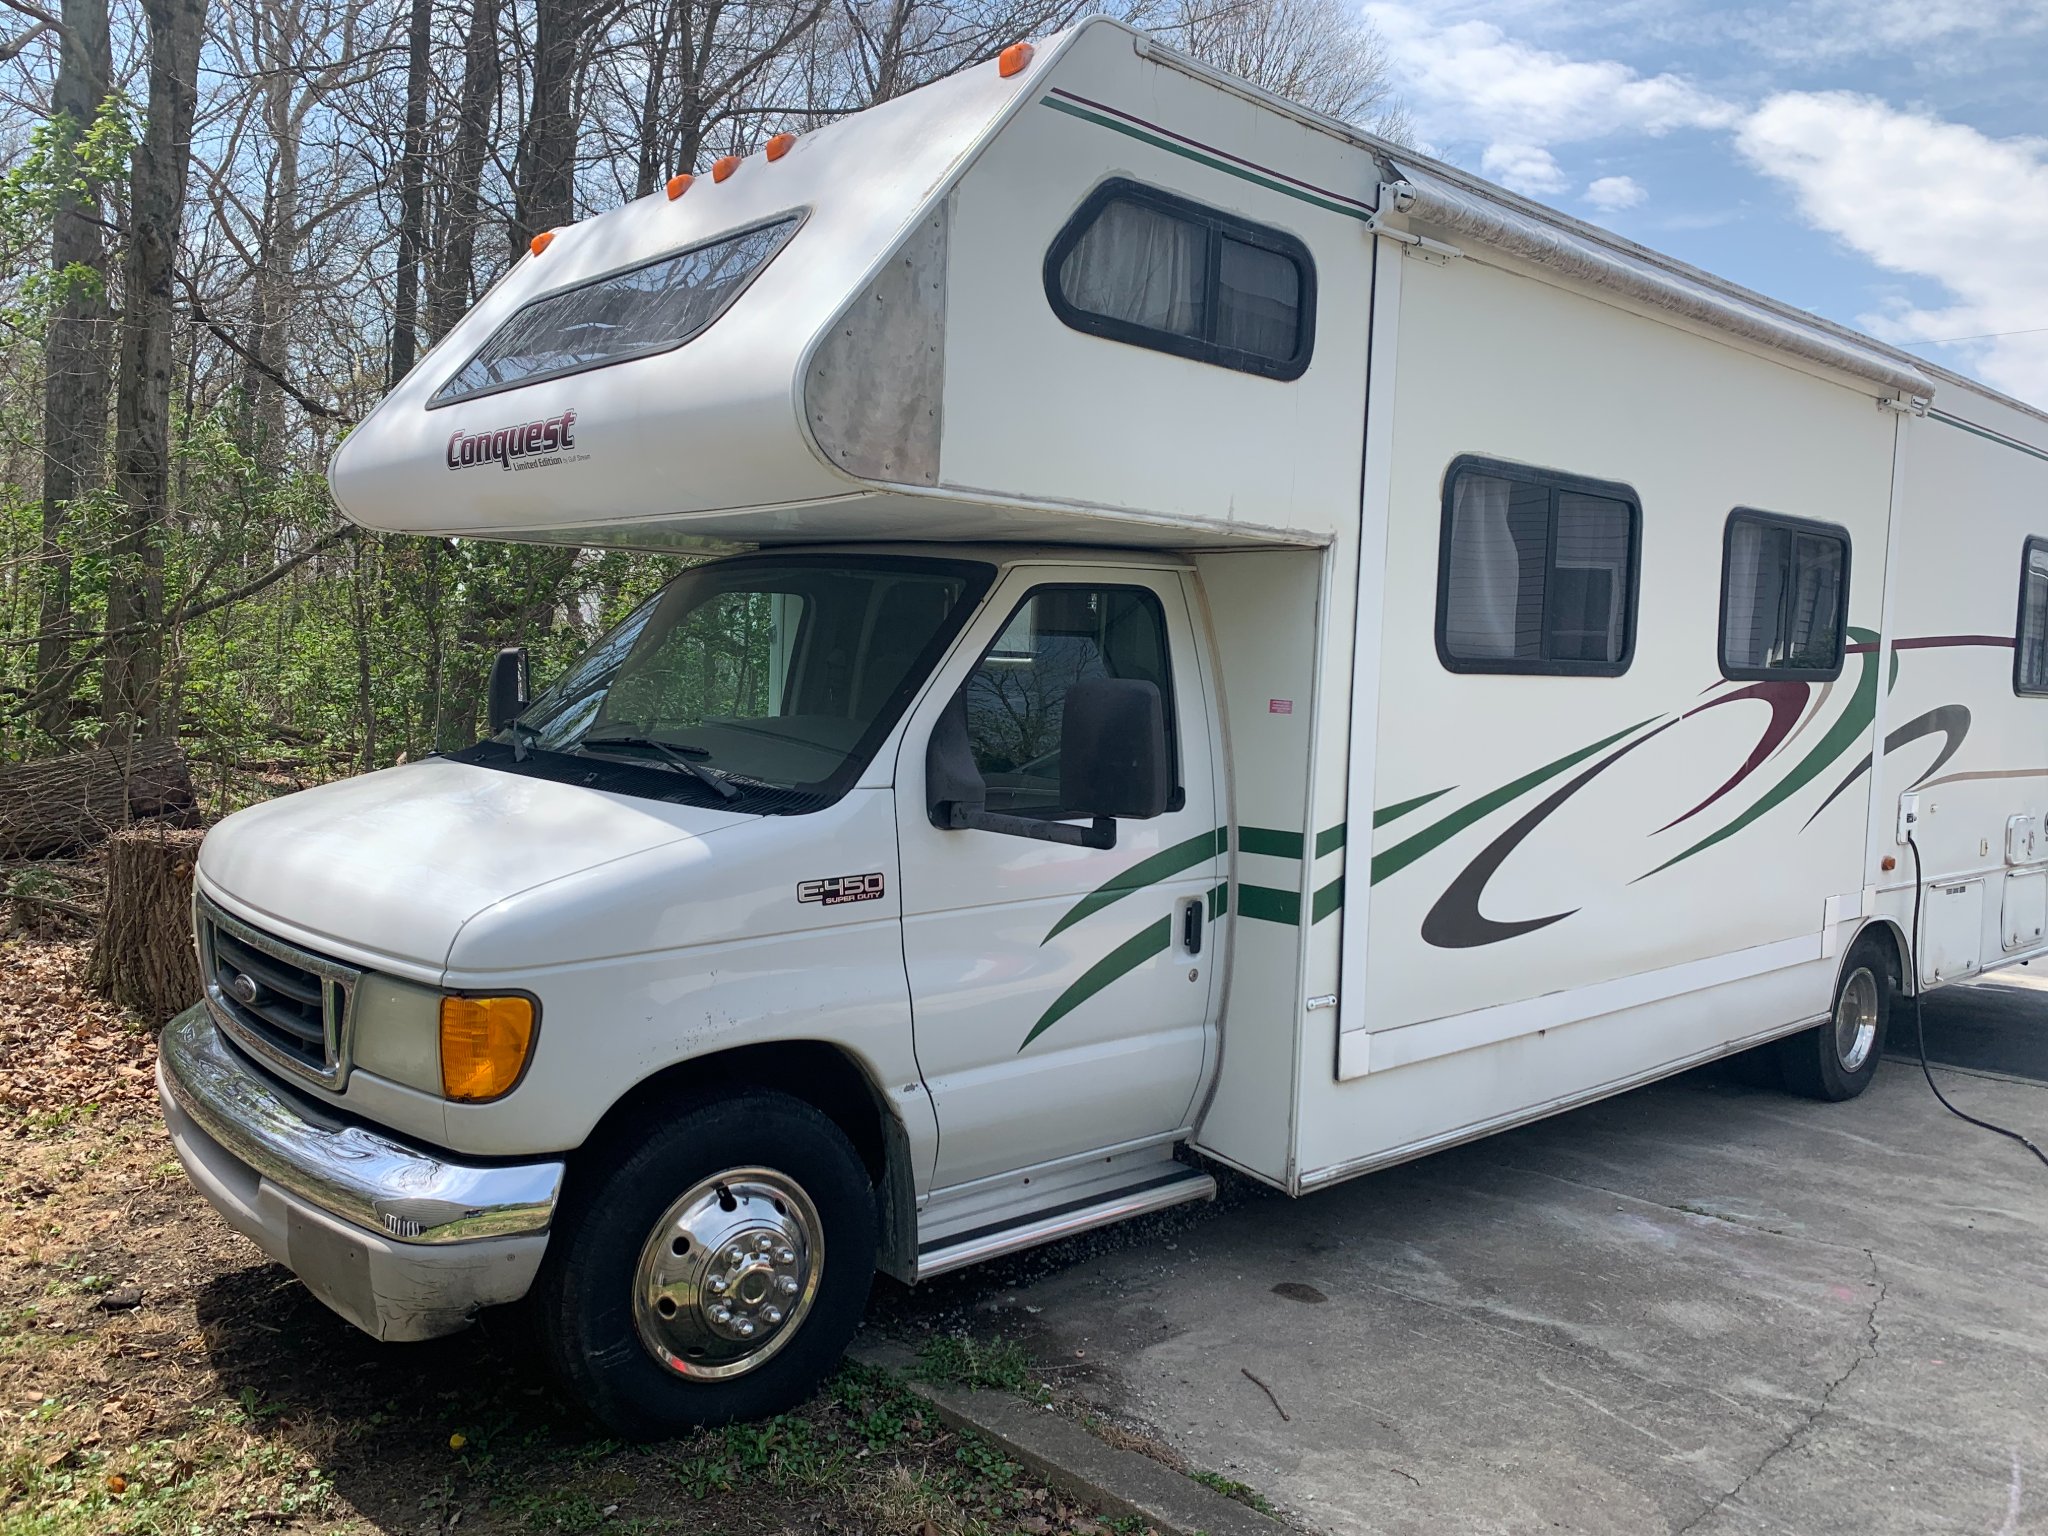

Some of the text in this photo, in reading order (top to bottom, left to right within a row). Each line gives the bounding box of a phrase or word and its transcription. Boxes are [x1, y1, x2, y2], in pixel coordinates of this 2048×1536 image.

[447, 408, 577, 471] Conquest
[513, 459, 539, 471] Limited
[539, 456, 563, 468] Edition
[825, 891, 881, 904] SUPER DUTY
